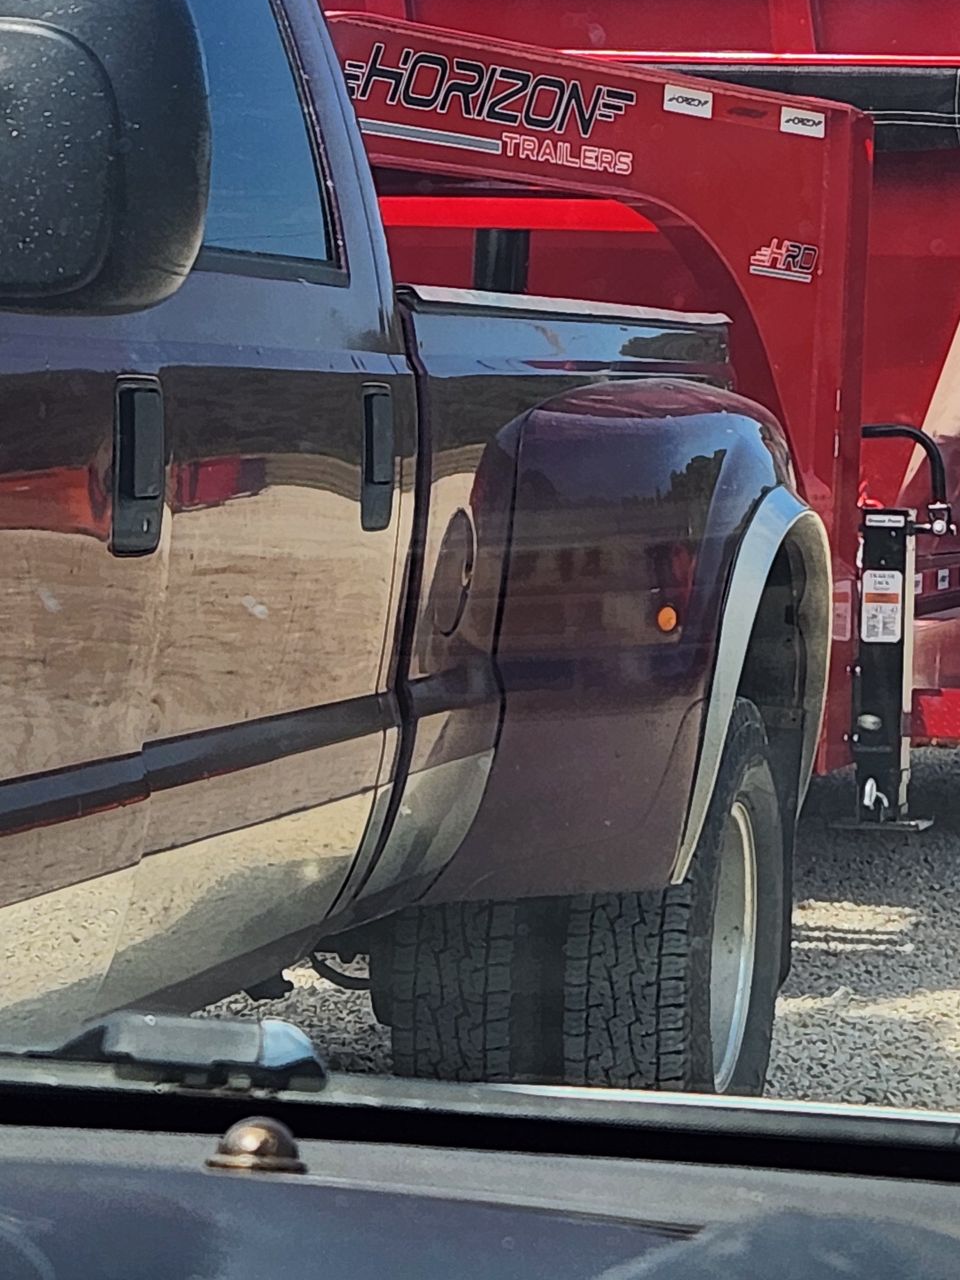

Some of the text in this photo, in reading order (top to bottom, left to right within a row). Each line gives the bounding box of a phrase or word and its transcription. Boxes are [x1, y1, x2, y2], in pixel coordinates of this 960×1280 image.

[357, 42, 604, 138] HORIZON
[502, 131, 633, 175] TRAILERS
[766, 237, 819, 273] HRD
